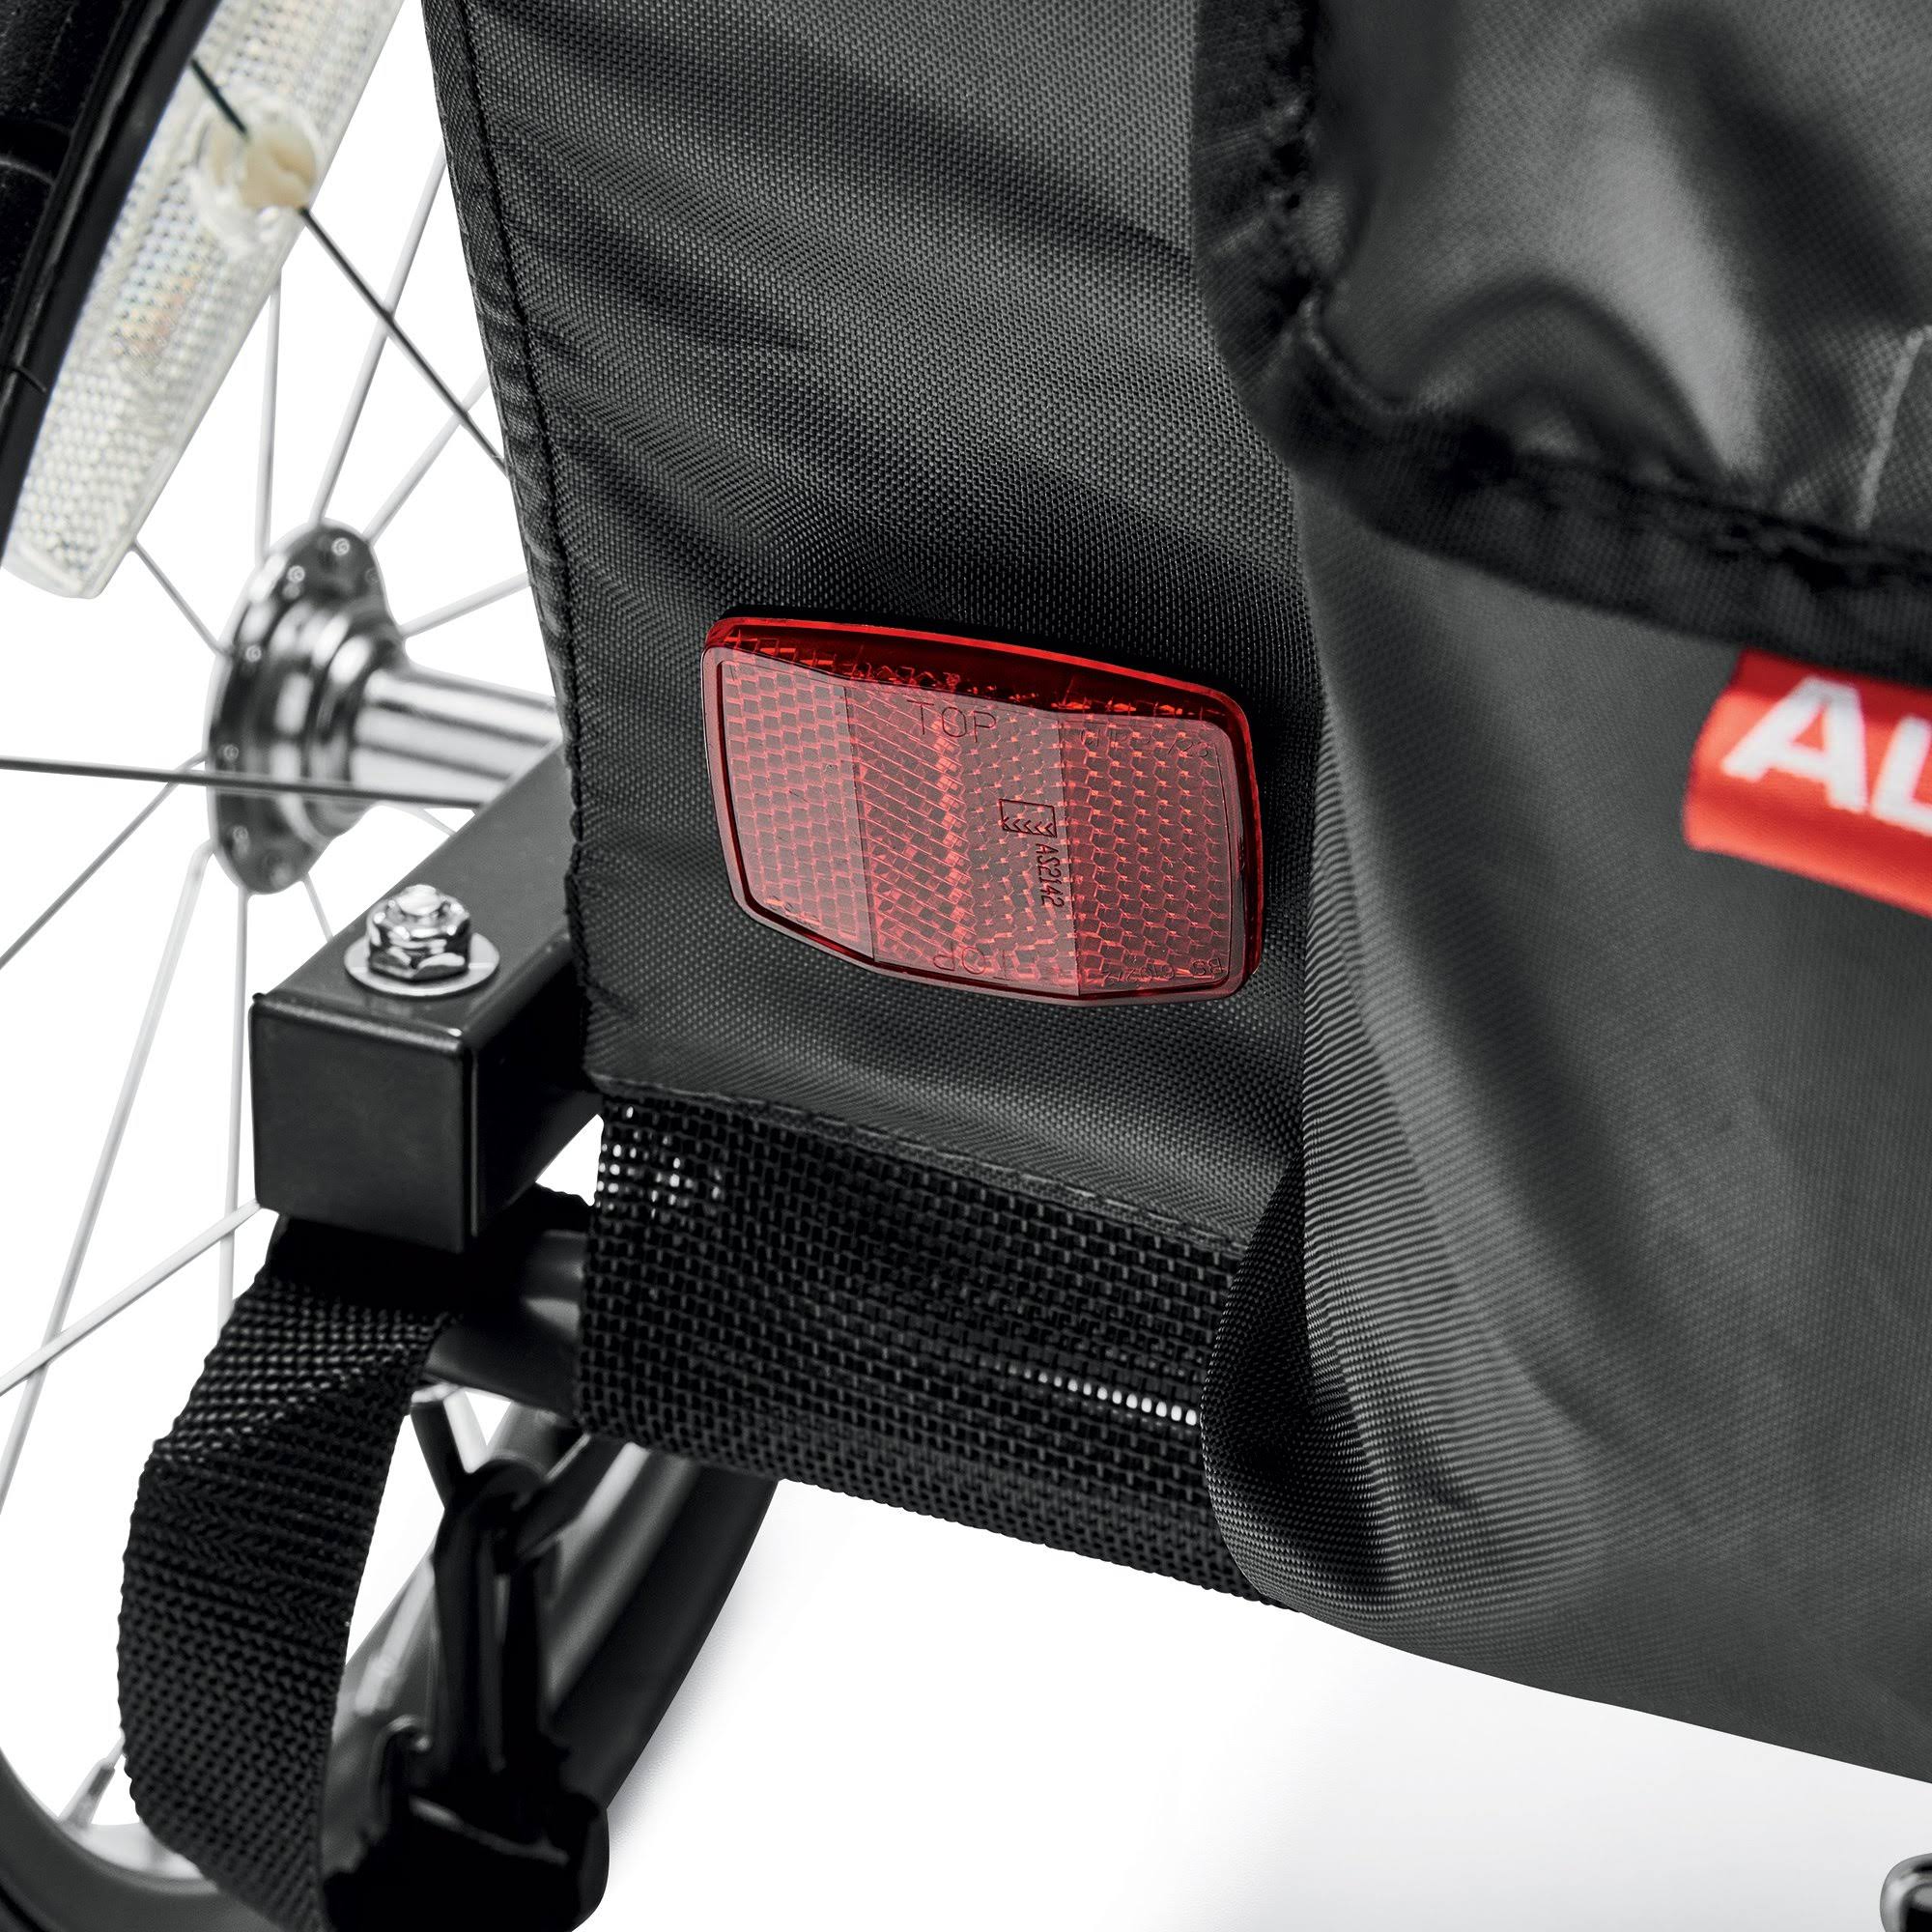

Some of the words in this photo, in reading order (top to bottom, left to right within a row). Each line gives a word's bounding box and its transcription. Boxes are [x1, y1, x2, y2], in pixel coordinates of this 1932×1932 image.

[906, 698, 997, 743] TOP
[1720, 674, 1932, 838] AL
[1036, 842, 1065, 908] AS2142
